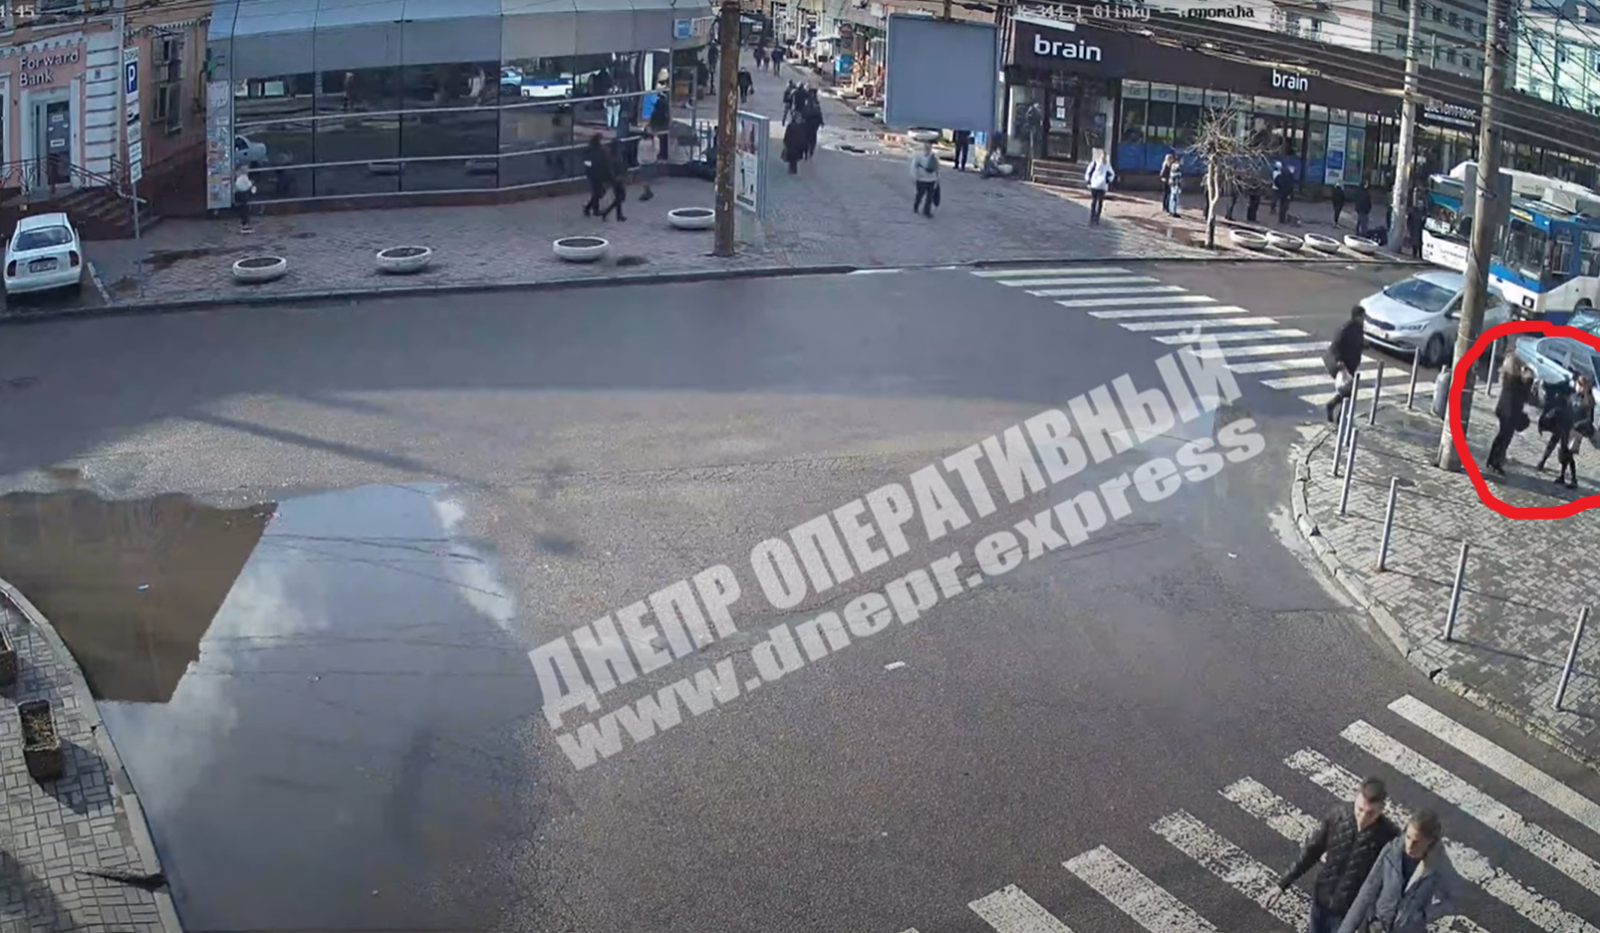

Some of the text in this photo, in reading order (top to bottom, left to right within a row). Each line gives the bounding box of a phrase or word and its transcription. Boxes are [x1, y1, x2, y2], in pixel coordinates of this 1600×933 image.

[20, 47, 80, 70] Forward
[1034, 33, 1102, 61] brain
[20, 69, 54, 88] Bank
[127, 64, 137, 92] P
[1272, 68, 1309, 92] brain
